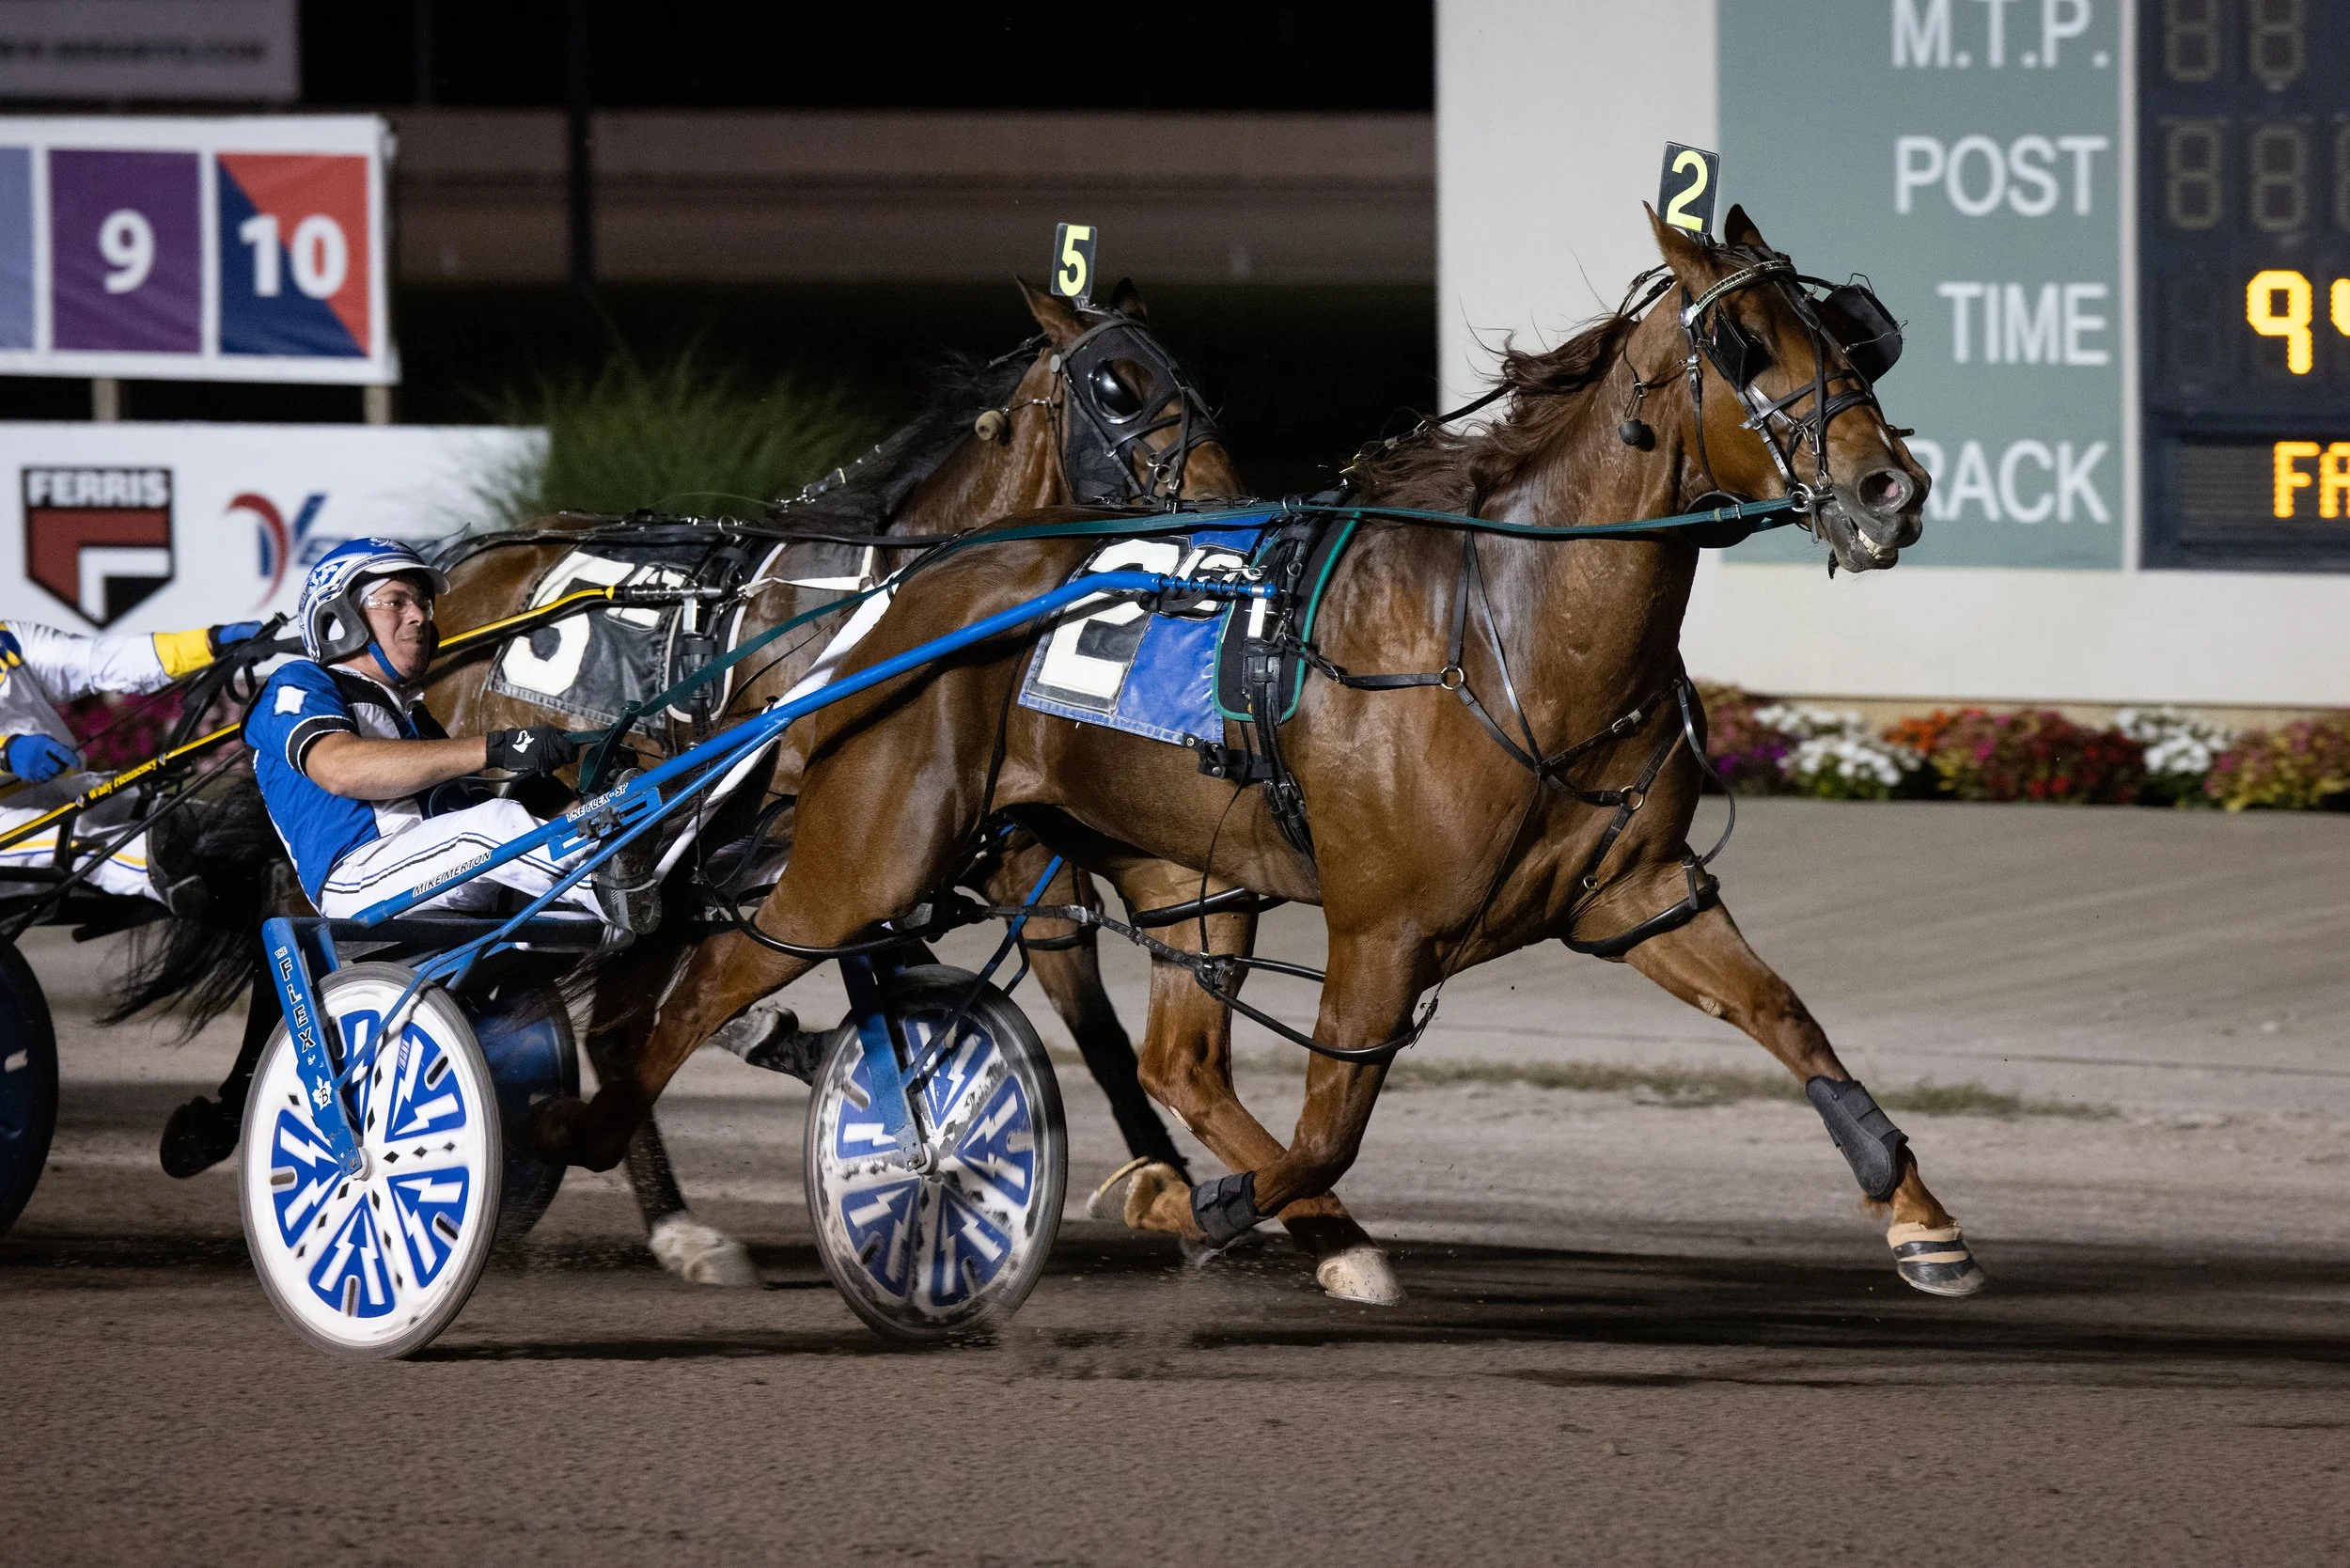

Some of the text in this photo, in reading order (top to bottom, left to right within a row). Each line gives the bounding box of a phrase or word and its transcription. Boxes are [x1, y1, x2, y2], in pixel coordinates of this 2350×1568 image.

[1667, 150, 1708, 231] 2
[1893, 135, 2109, 217] POST
[98, 209, 156, 295] 9
[239, 214, 349, 300] 10
[1058, 225, 1090, 296] 5
[1937, 282, 2109, 366] TIME
[27, 470, 169, 508] FERRIS
[1903, 438, 2110, 524] RACK
[501, 551, 635, 697] 5
[1037, 538, 1180, 699] 2
[413, 849, 493, 897] MIKE MERTON
[279, 957, 317, 1054] FLEX
